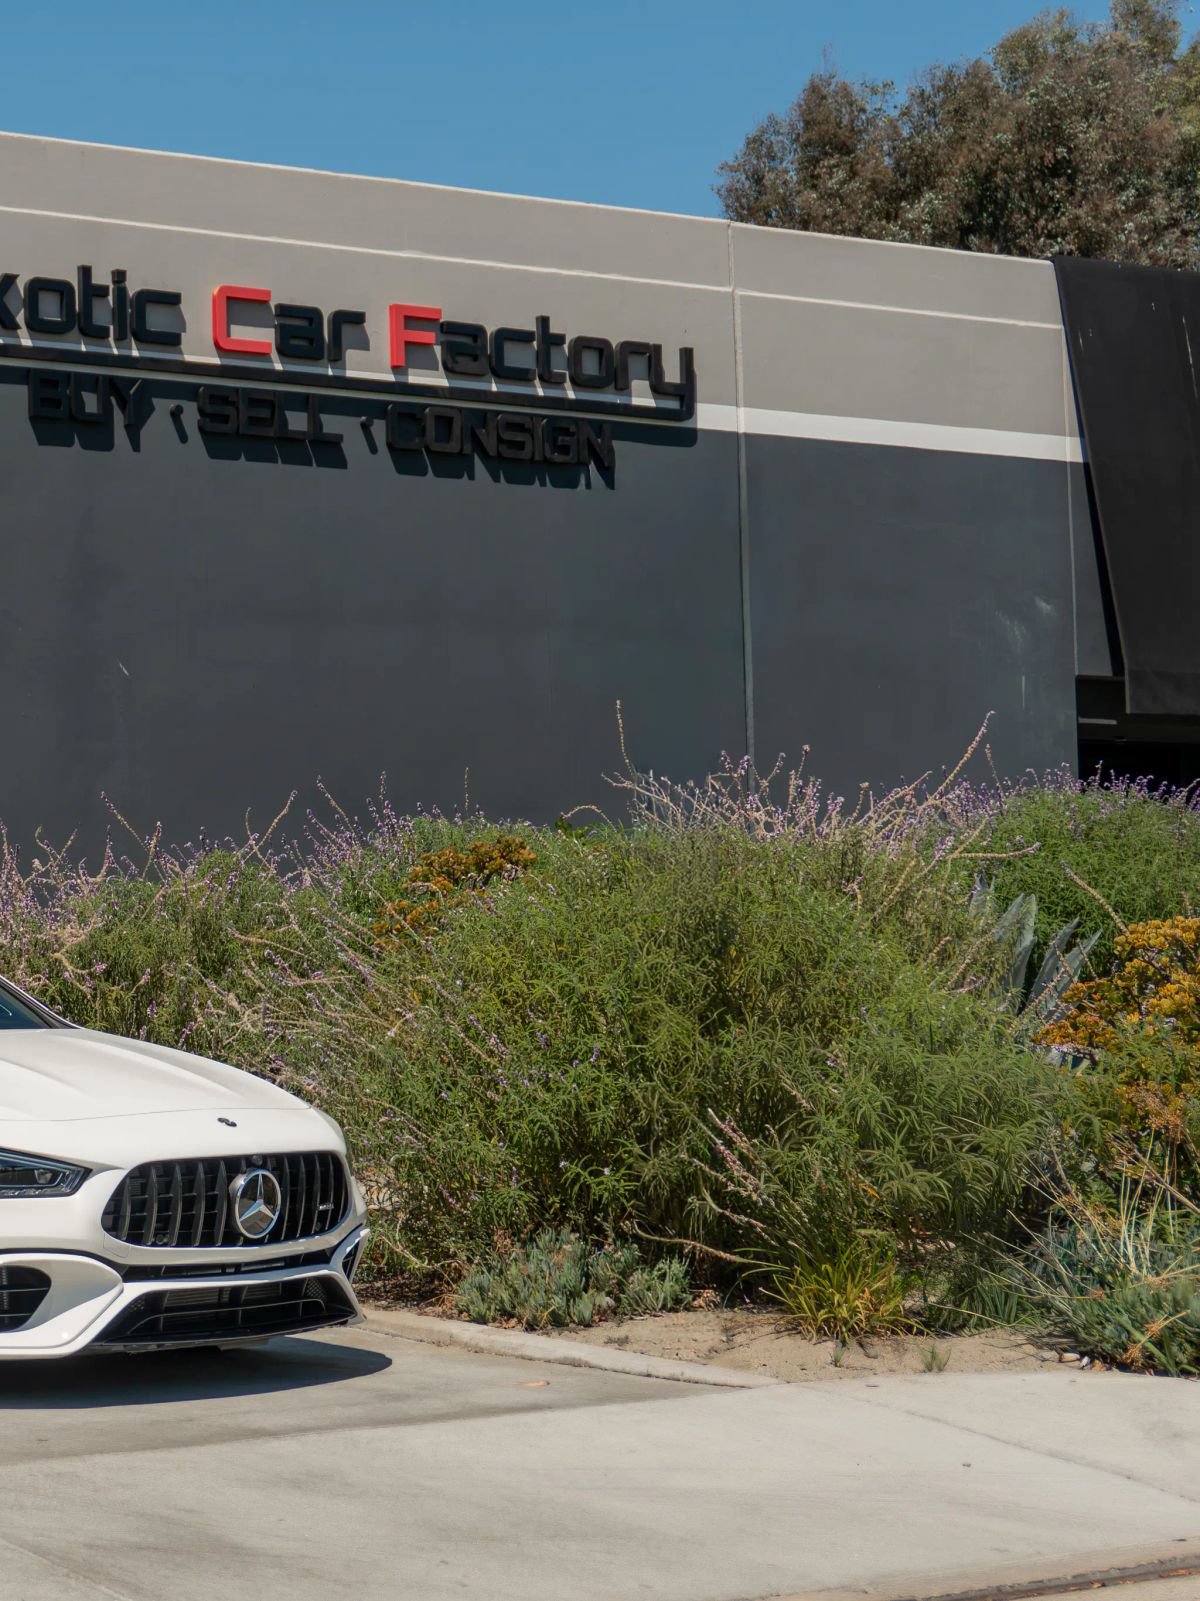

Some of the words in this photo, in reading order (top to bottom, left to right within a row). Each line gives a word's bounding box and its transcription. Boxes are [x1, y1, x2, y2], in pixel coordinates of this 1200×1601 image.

[212, 284, 366, 362] Car
[389, 303, 695, 421] Factory
[28, 367, 144, 425] BUY
[197, 385, 344, 443] SELL
[386, 403, 614, 468] CONSIGN
